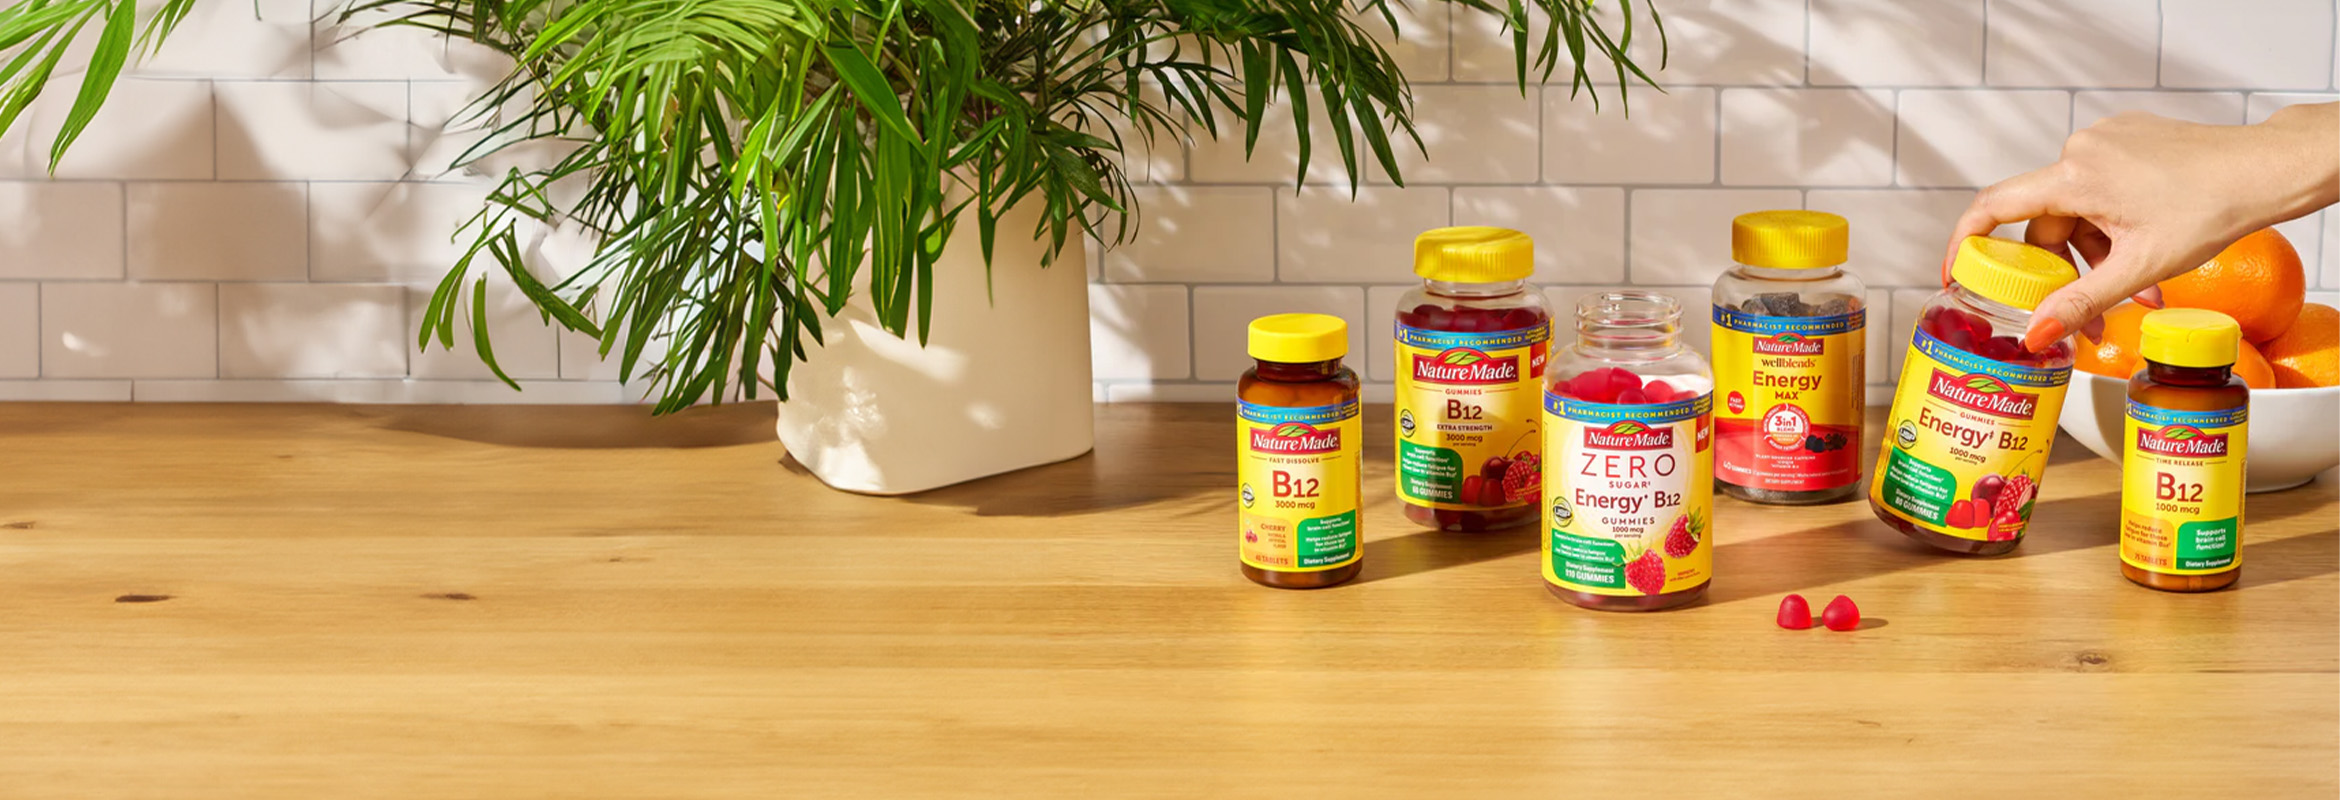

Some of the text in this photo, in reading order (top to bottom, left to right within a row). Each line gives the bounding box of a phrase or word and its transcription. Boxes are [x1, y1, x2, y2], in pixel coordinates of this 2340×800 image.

[1734, 319, 1782, 330] PHARMACIST
[1786, 321, 1845, 331] RECOMMENDED
[1410, 335, 1455, 345] PHARMACIST
[1459, 336, 1523, 346] RECOMMENDED
[1532, 353, 1545, 368] NEW
[1934, 347, 1983, 370] PHARMACIST
[1986, 367, 2048, 382] RECOMMENDED
[1753, 370, 1822, 391] Energy
[1775, 391, 1799, 400] MAX
[1447, 399, 1482, 420] B12
[1567, 407, 1621, 418] PHARMACIST
[1624, 407, 1690, 419] RECOMMENDED
[1284, 411, 1340, 421] RECOMMENDED
[1960, 411, 1995, 426] GUMMIES
[1458, 424, 1493, 432] STRENGTH
[1697, 426, 1710, 442] NEW
[1446, 433, 1483, 443] 3000 mcg
[1998, 430, 2028, 451] B12
[1949, 446, 1986, 464] 1000 mcg
[1580, 452, 1676, 479] ZERO
[2156, 457, 2204, 467] TIME RELEASE
[1272, 470, 1320, 498] B12
[2156, 471, 2203, 502] B12
[1420, 487, 1453, 499] GUMMIES
[1275, 500, 1316, 509] 3000 mcg
[1654, 491, 1681, 508] B12
[1903, 500, 1939, 520] GUMMIES
[2156, 502, 2200, 515] 1000 mcg
[1601, 516, 1655, 525] GUMMIES
[1260, 523, 1286, 531] CHERRY
[1629, 526, 1644, 534] mcg
[2196, 528, 2226, 536] Supports
[2195, 535, 2213, 543] brain
[2185, 557, 2231, 568] Dietary Supplement
[1576, 570, 1615, 583] GUMMIES
